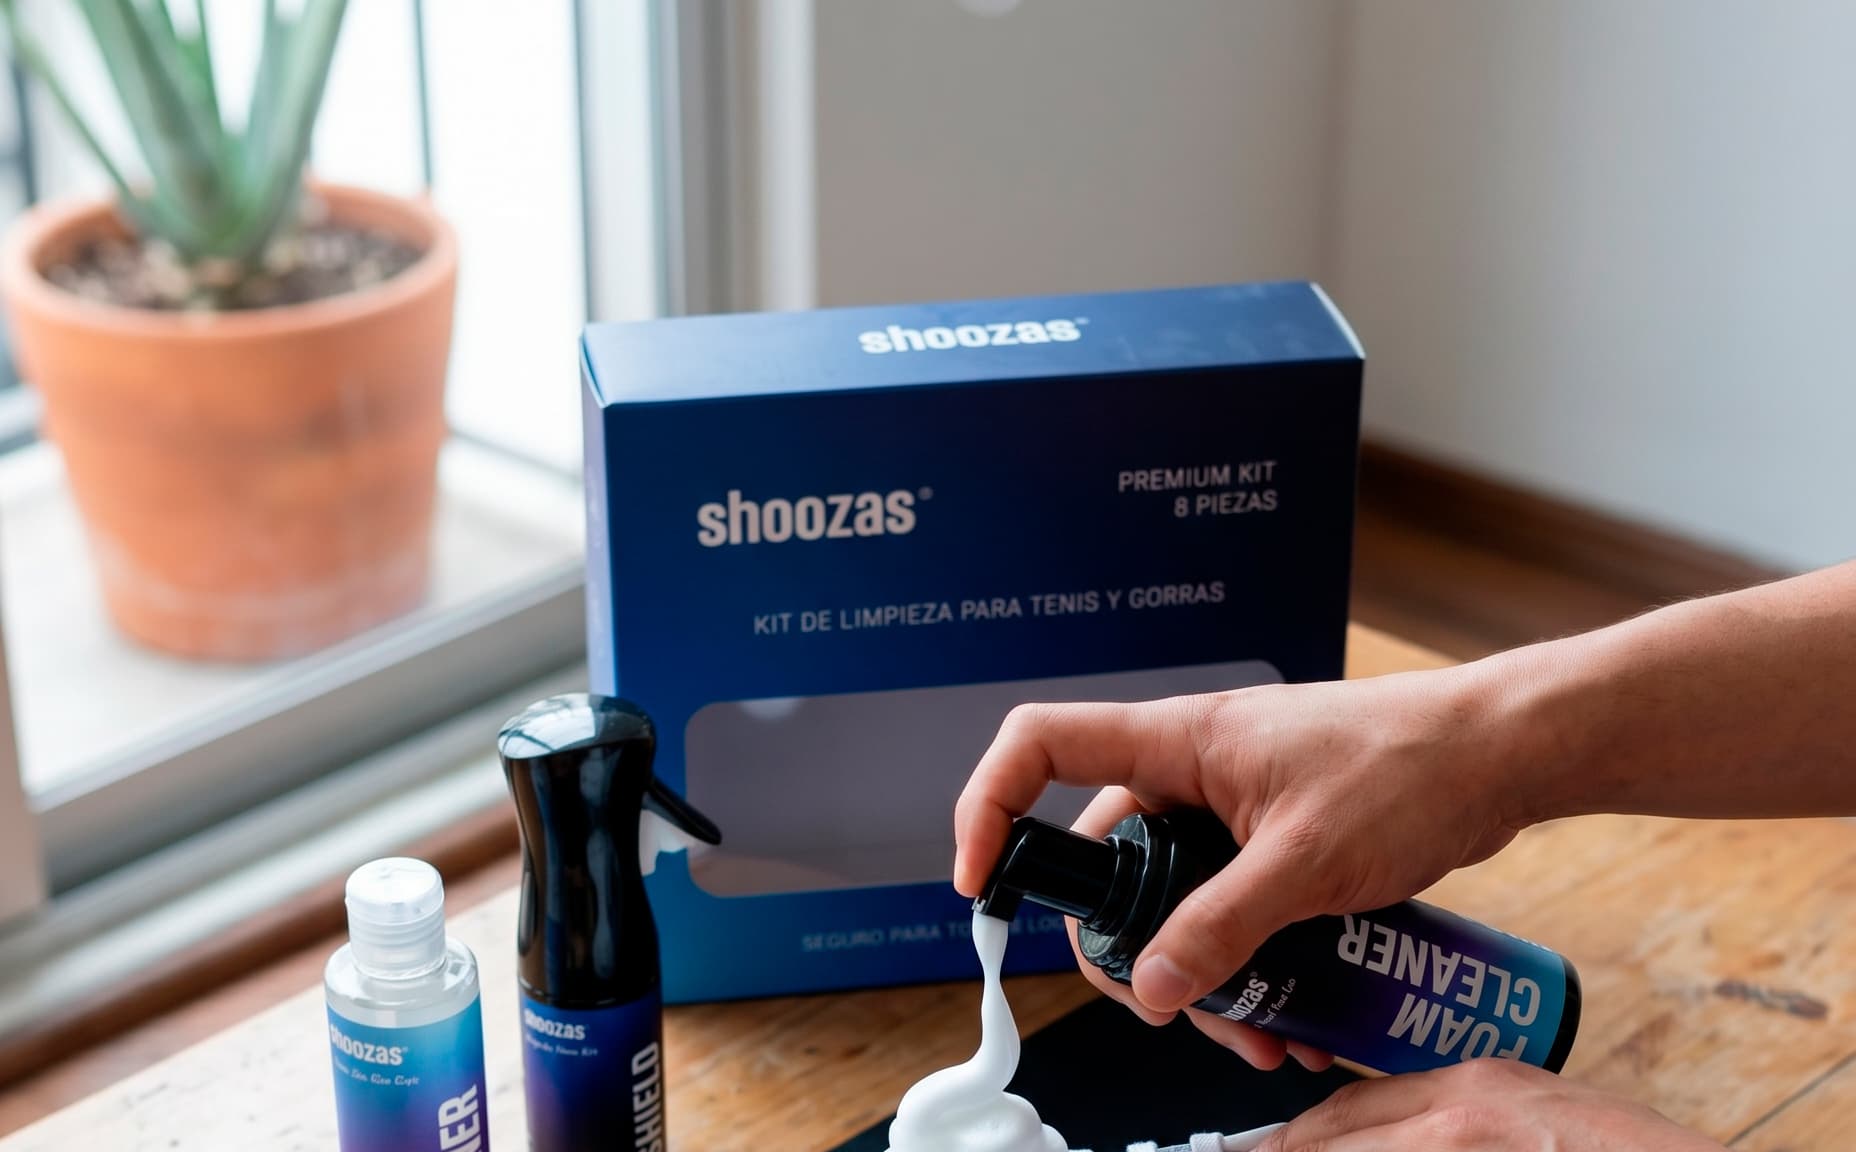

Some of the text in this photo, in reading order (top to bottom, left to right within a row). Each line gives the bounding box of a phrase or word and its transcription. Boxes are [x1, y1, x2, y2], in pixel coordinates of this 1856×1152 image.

[858, 318, 1082, 354] shoozas
[1118, 461, 1277, 492] PREMIUM KIT
[697, 489, 917, 547] shoozas
[1174, 489, 1278, 518] 8 PIEZAS
[754, 581, 1225, 635] KIT DE LIMPIEZA PARA TENIS Y GORRAS
[889, 923, 941, 943] PARA
[1338, 912, 1541, 1026] CLEANER
